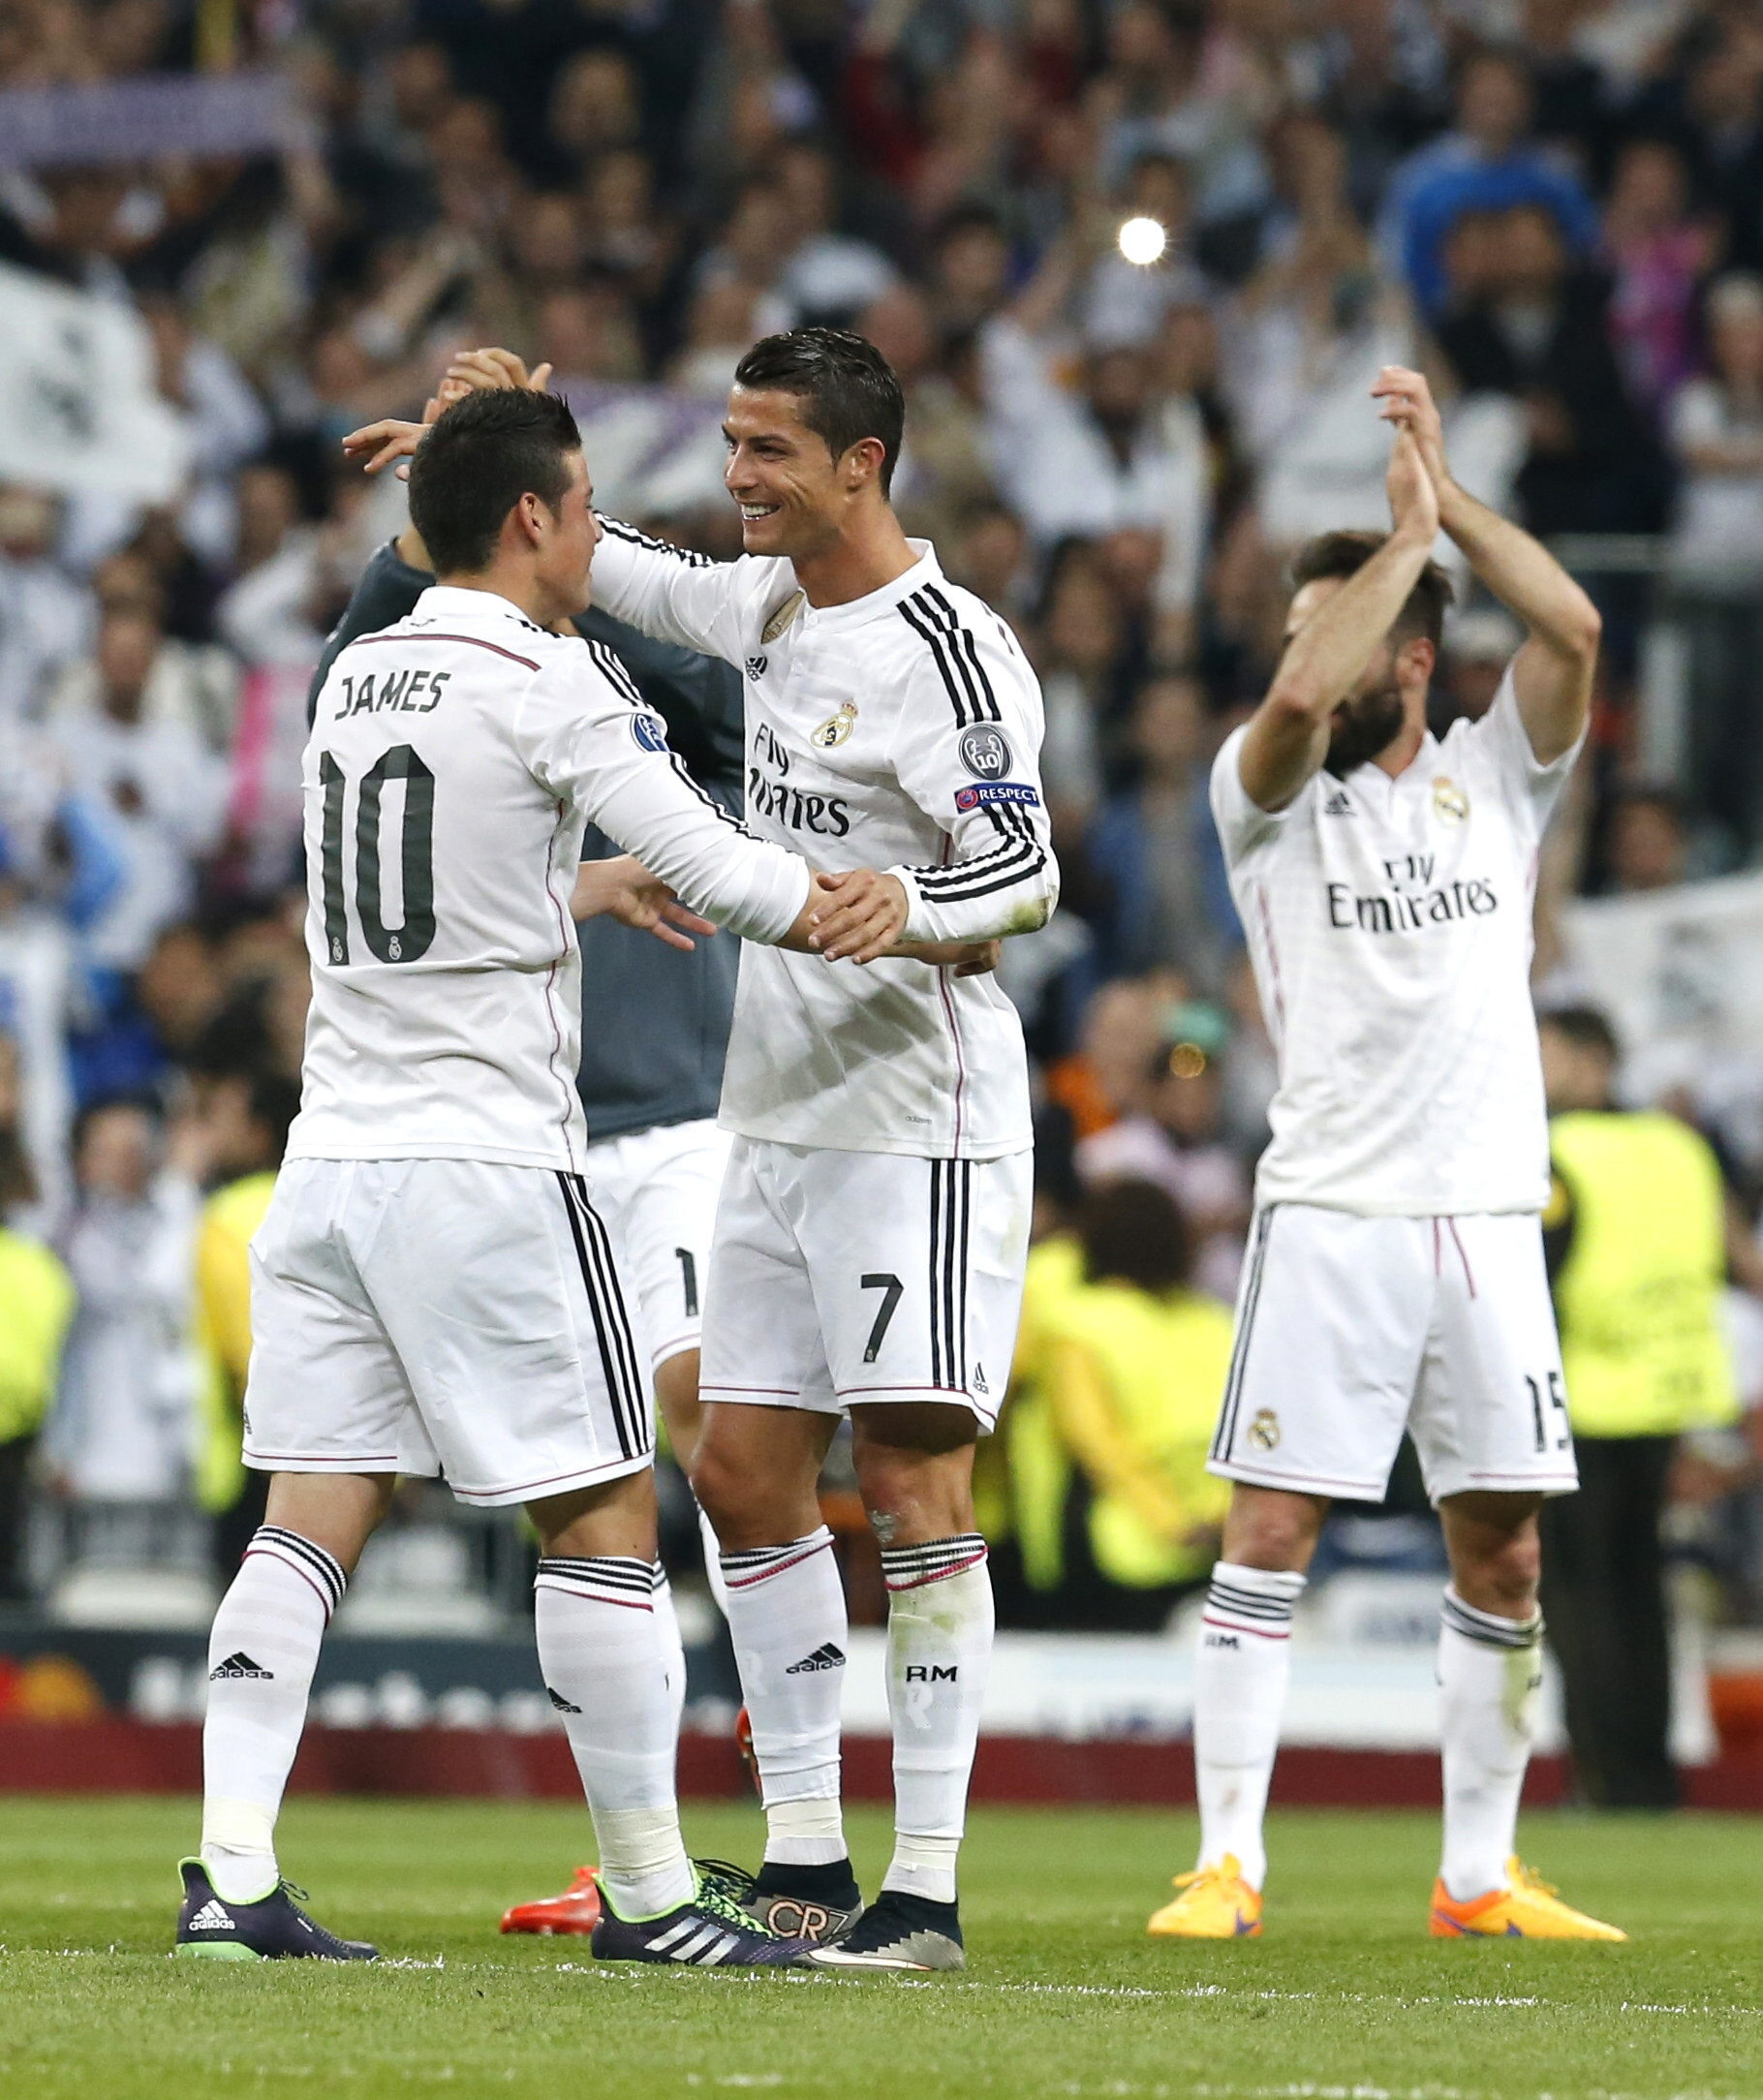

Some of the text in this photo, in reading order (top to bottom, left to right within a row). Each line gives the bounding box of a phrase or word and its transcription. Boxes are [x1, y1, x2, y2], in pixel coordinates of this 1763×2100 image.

[334, 670, 451, 721] JAMES
[754, 722, 789, 777] Fly
[977, 754, 999, 769] 10
[979, 788, 1037, 801] RESPECT
[319, 744, 436, 966] 10
[1383, 852, 1436, 885] Fly
[1327, 878, 1498, 934] Emirates
[861, 1273, 904, 1363] 7
[906, 1665, 958, 1682] RM
[768, 1899, 849, 1943] CR7
